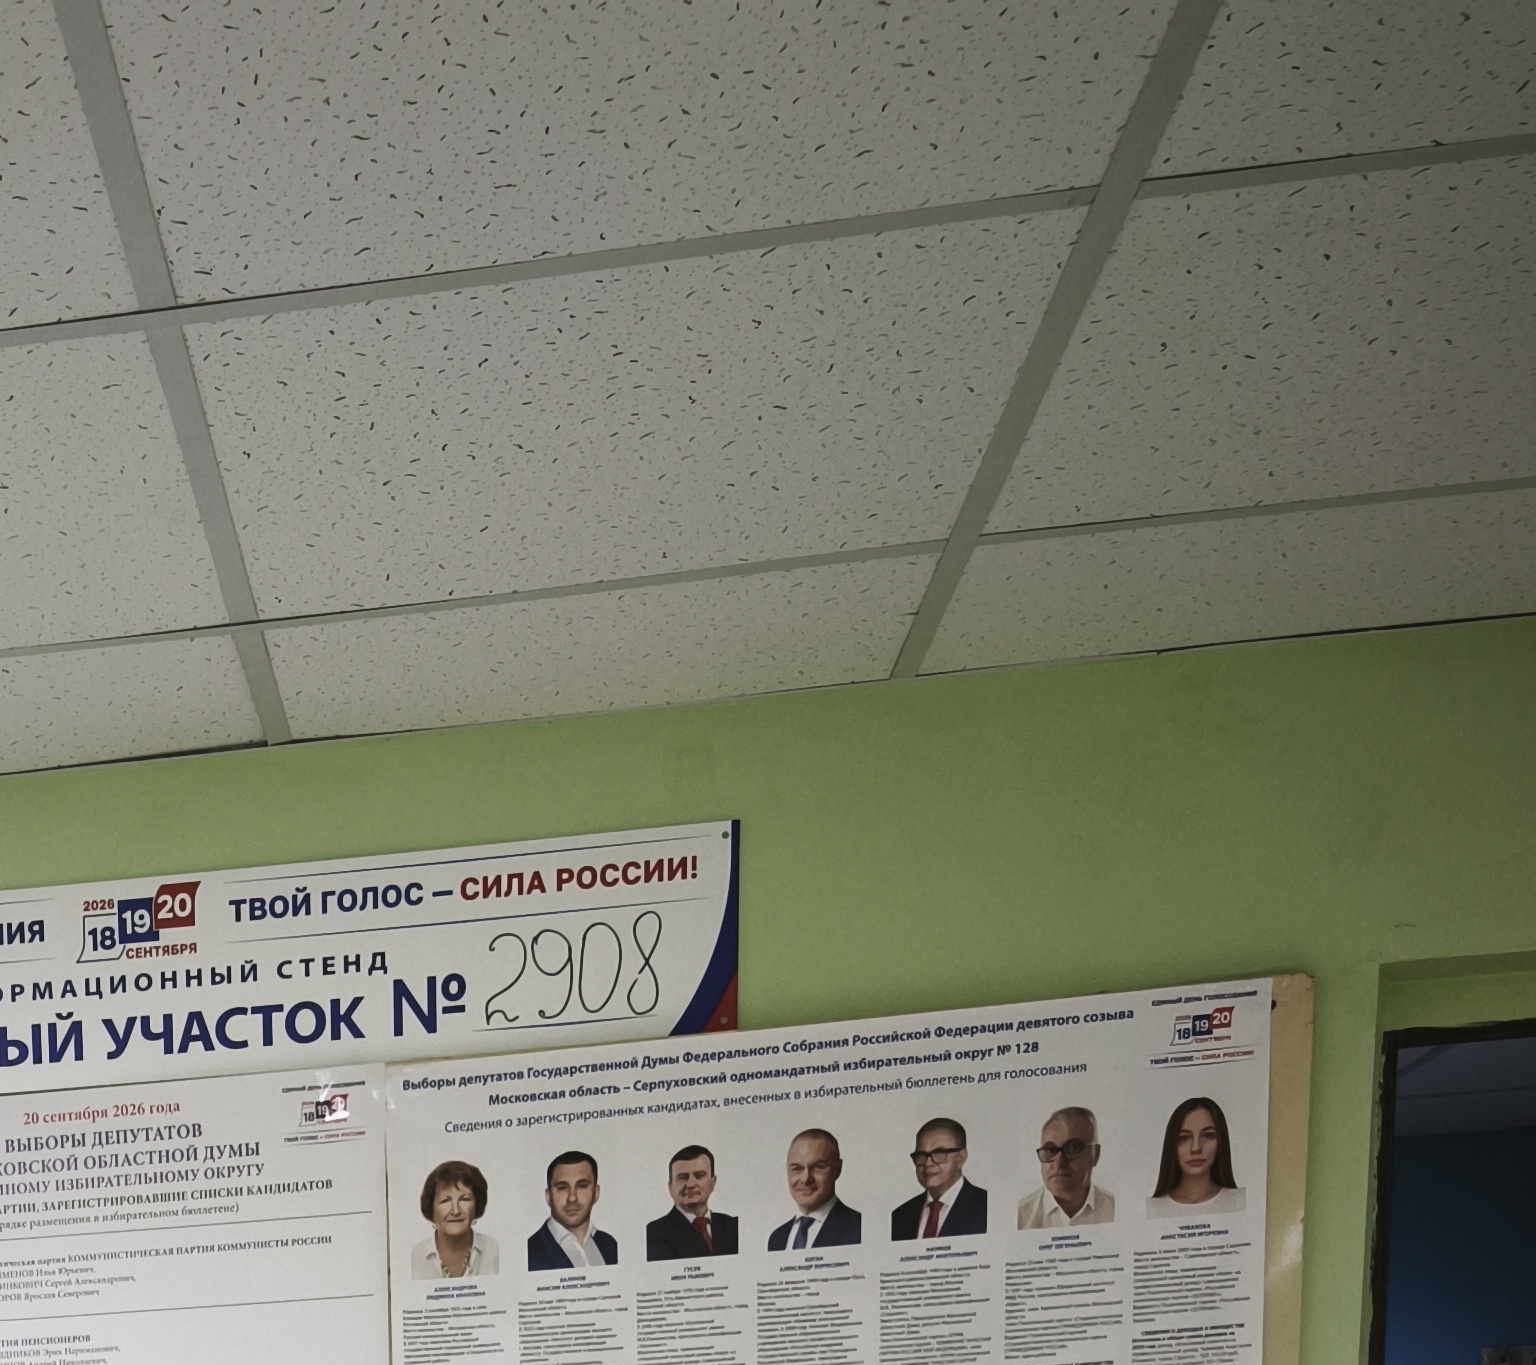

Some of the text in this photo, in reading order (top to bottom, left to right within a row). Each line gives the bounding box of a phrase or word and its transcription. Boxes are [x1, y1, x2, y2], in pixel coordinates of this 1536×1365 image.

[228, 887, 311, 922] ТВОЙ
[321, 882, 423, 913] ГОЛОС
[460, 870, 546, 900] СИЛА
[556, 856, 697, 890] РОССИИ!
[83, 899, 115, 912] 2026
[157, 893, 192, 919] 20
[122, 909, 151, 935] 19
[88, 926, 117, 951] 18
[126, 943, 197, 959] СЕНТЯБРЯ
[276, 951, 387, 978] СТЕНД
[484, 911, 663, 1025] 2908
[101, 996, 365, 1060] УЧАСТОК
[392, 973, 466, 1037] №
[1195, 1020, 1208, 1031] 19
[1213, 1012, 1230, 1025] 20
[1177, 1028, 1190, 1040] 18
[402, 1009, 1134, 1090] Выборы депутатов Государственной Думы Федерального Собрания Российской Федерации девятого созыва
[488, 1089, 565, 1105] Московская
[568, 1085, 620, 1097] область
[632, 1071, 726, 1092] Серпуховский
[729, 1060, 840, 1082] одномандатный
[843, 1049, 951, 1070] избирательный
[954, 1047, 994, 1061] округ
[996, 1044, 1011, 1056] №
[1014, 1041, 1039, 1054] 128
[444, 1063, 1087, 1133] Сведения о зарегистрированных кандидатах, внесенных в избирательный бюллетень для голосования
[23, 1102, 180, 1125] 20 сентября 2026 года
[4, 1123, 202, 1152] ВЫБОРЫ ДЕПУТАТОВ
[83, 1144, 198, 1169] ОБЛАСТНОЙ
[202, 1141, 260, 1163] ДУМЫ
[55, 1168, 200, 1190] ИЗБИРАТЕЛЬНОМУ
[203, 1163, 264, 1179] ОКРУГУ
[41, 1191, 188, 1210] ЗАРЕГИСТРИРОВАВШИЕ
[190, 1186, 243, 1199] СПИСКИ
[246, 1179, 332, 1195] КАНДИДАТОВ
